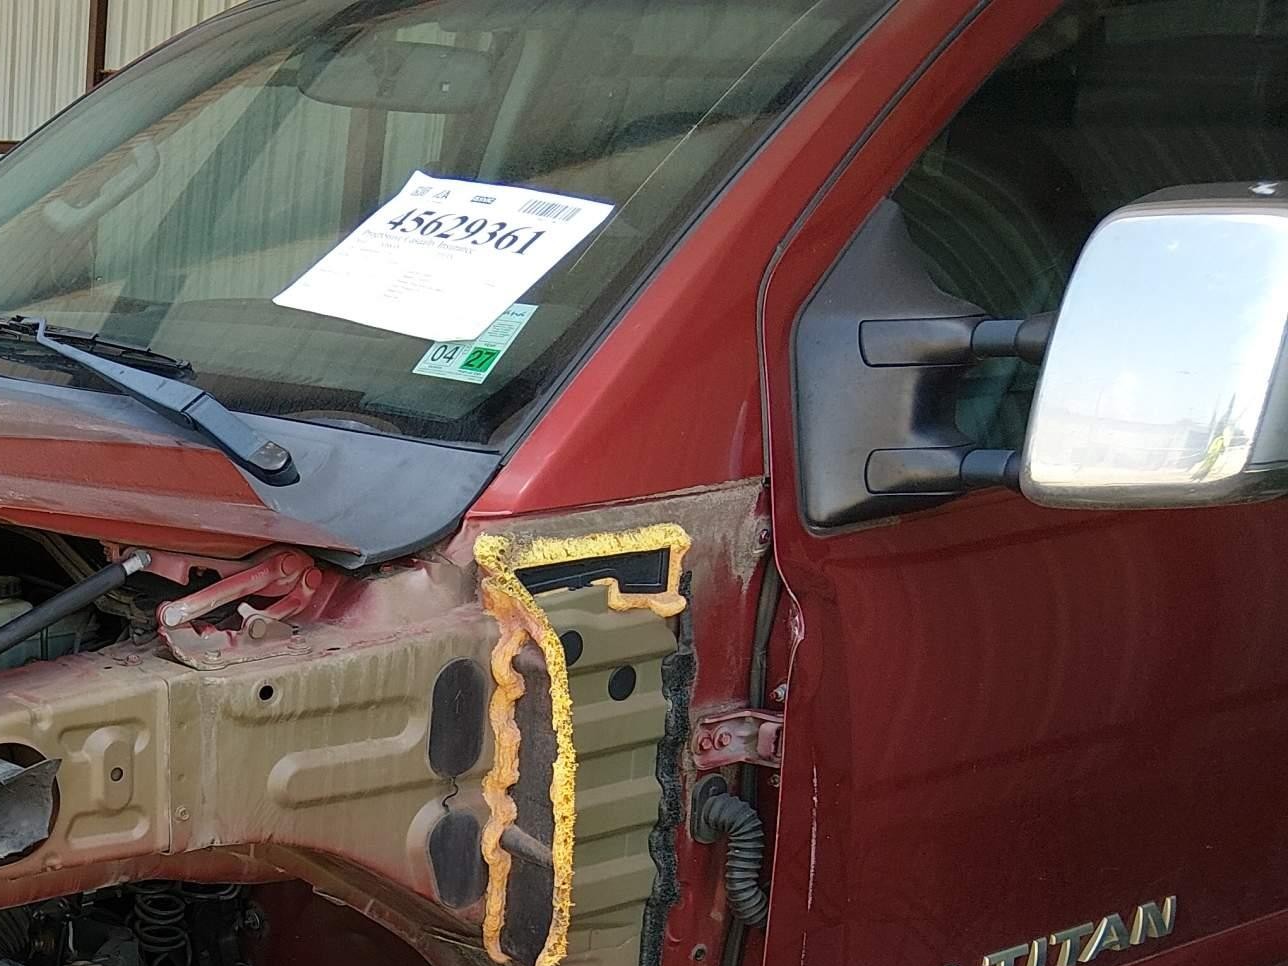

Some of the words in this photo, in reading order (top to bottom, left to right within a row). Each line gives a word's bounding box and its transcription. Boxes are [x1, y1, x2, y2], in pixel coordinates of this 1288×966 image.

[387, 207, 546, 254] 45629361
[430, 344, 460, 363] 04
[463, 349, 497, 368] 27
